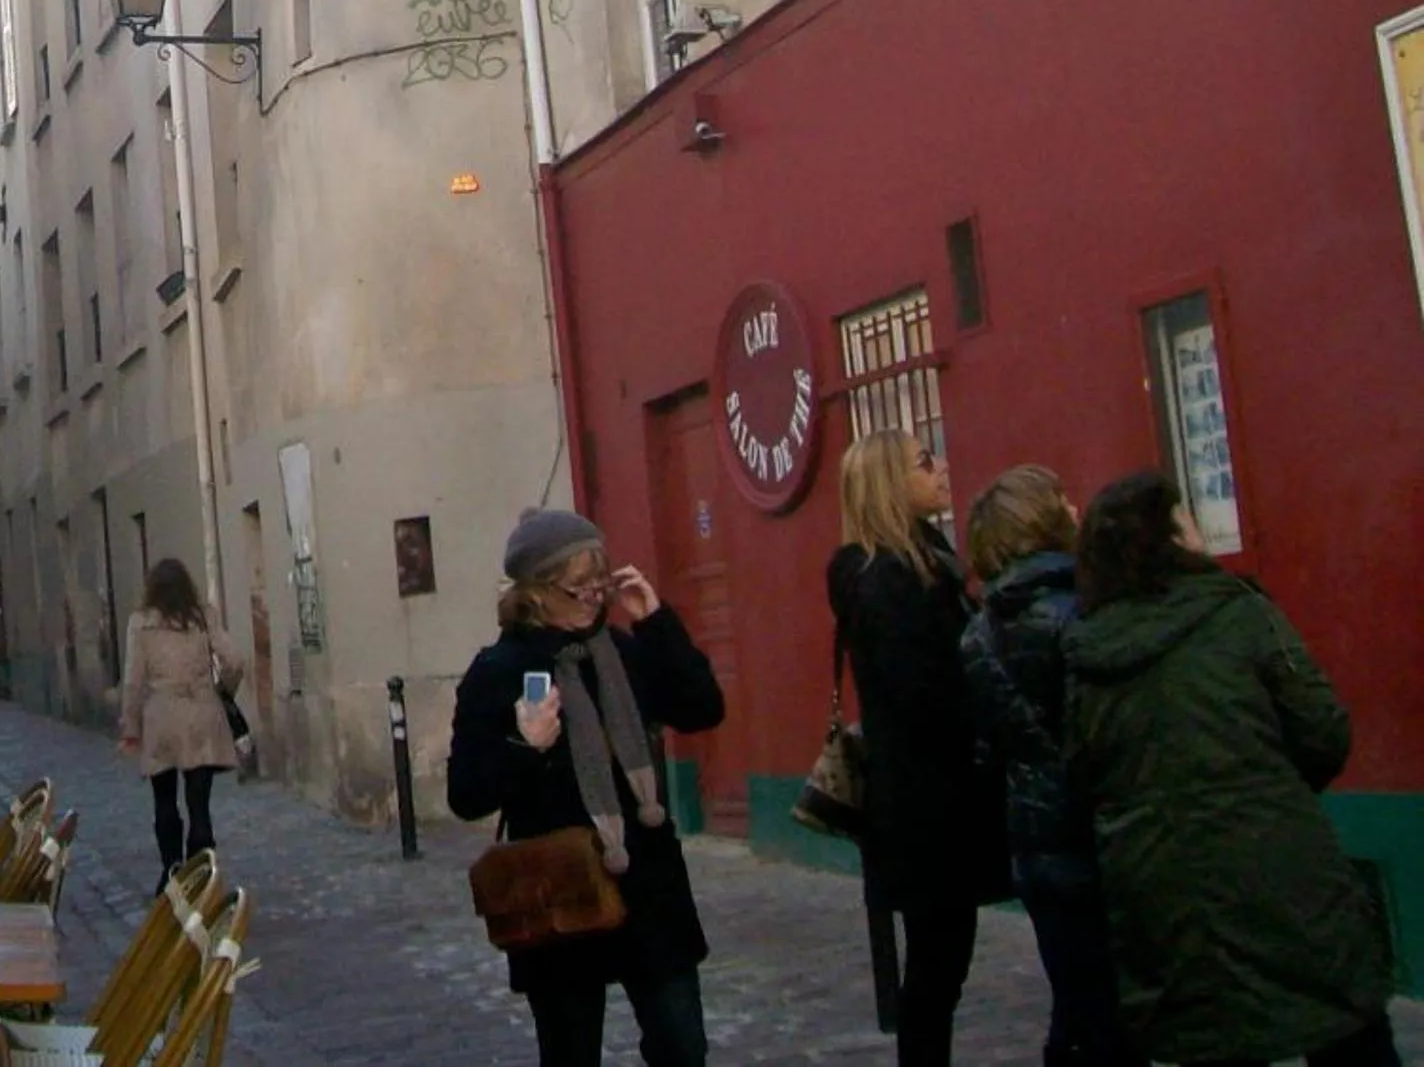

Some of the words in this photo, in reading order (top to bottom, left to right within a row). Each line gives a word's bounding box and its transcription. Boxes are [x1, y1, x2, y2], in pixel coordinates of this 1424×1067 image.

[743, 302, 779, 358] CAFÉ
[727, 391, 769, 481] SALON
[772, 437, 793, 481] DE
